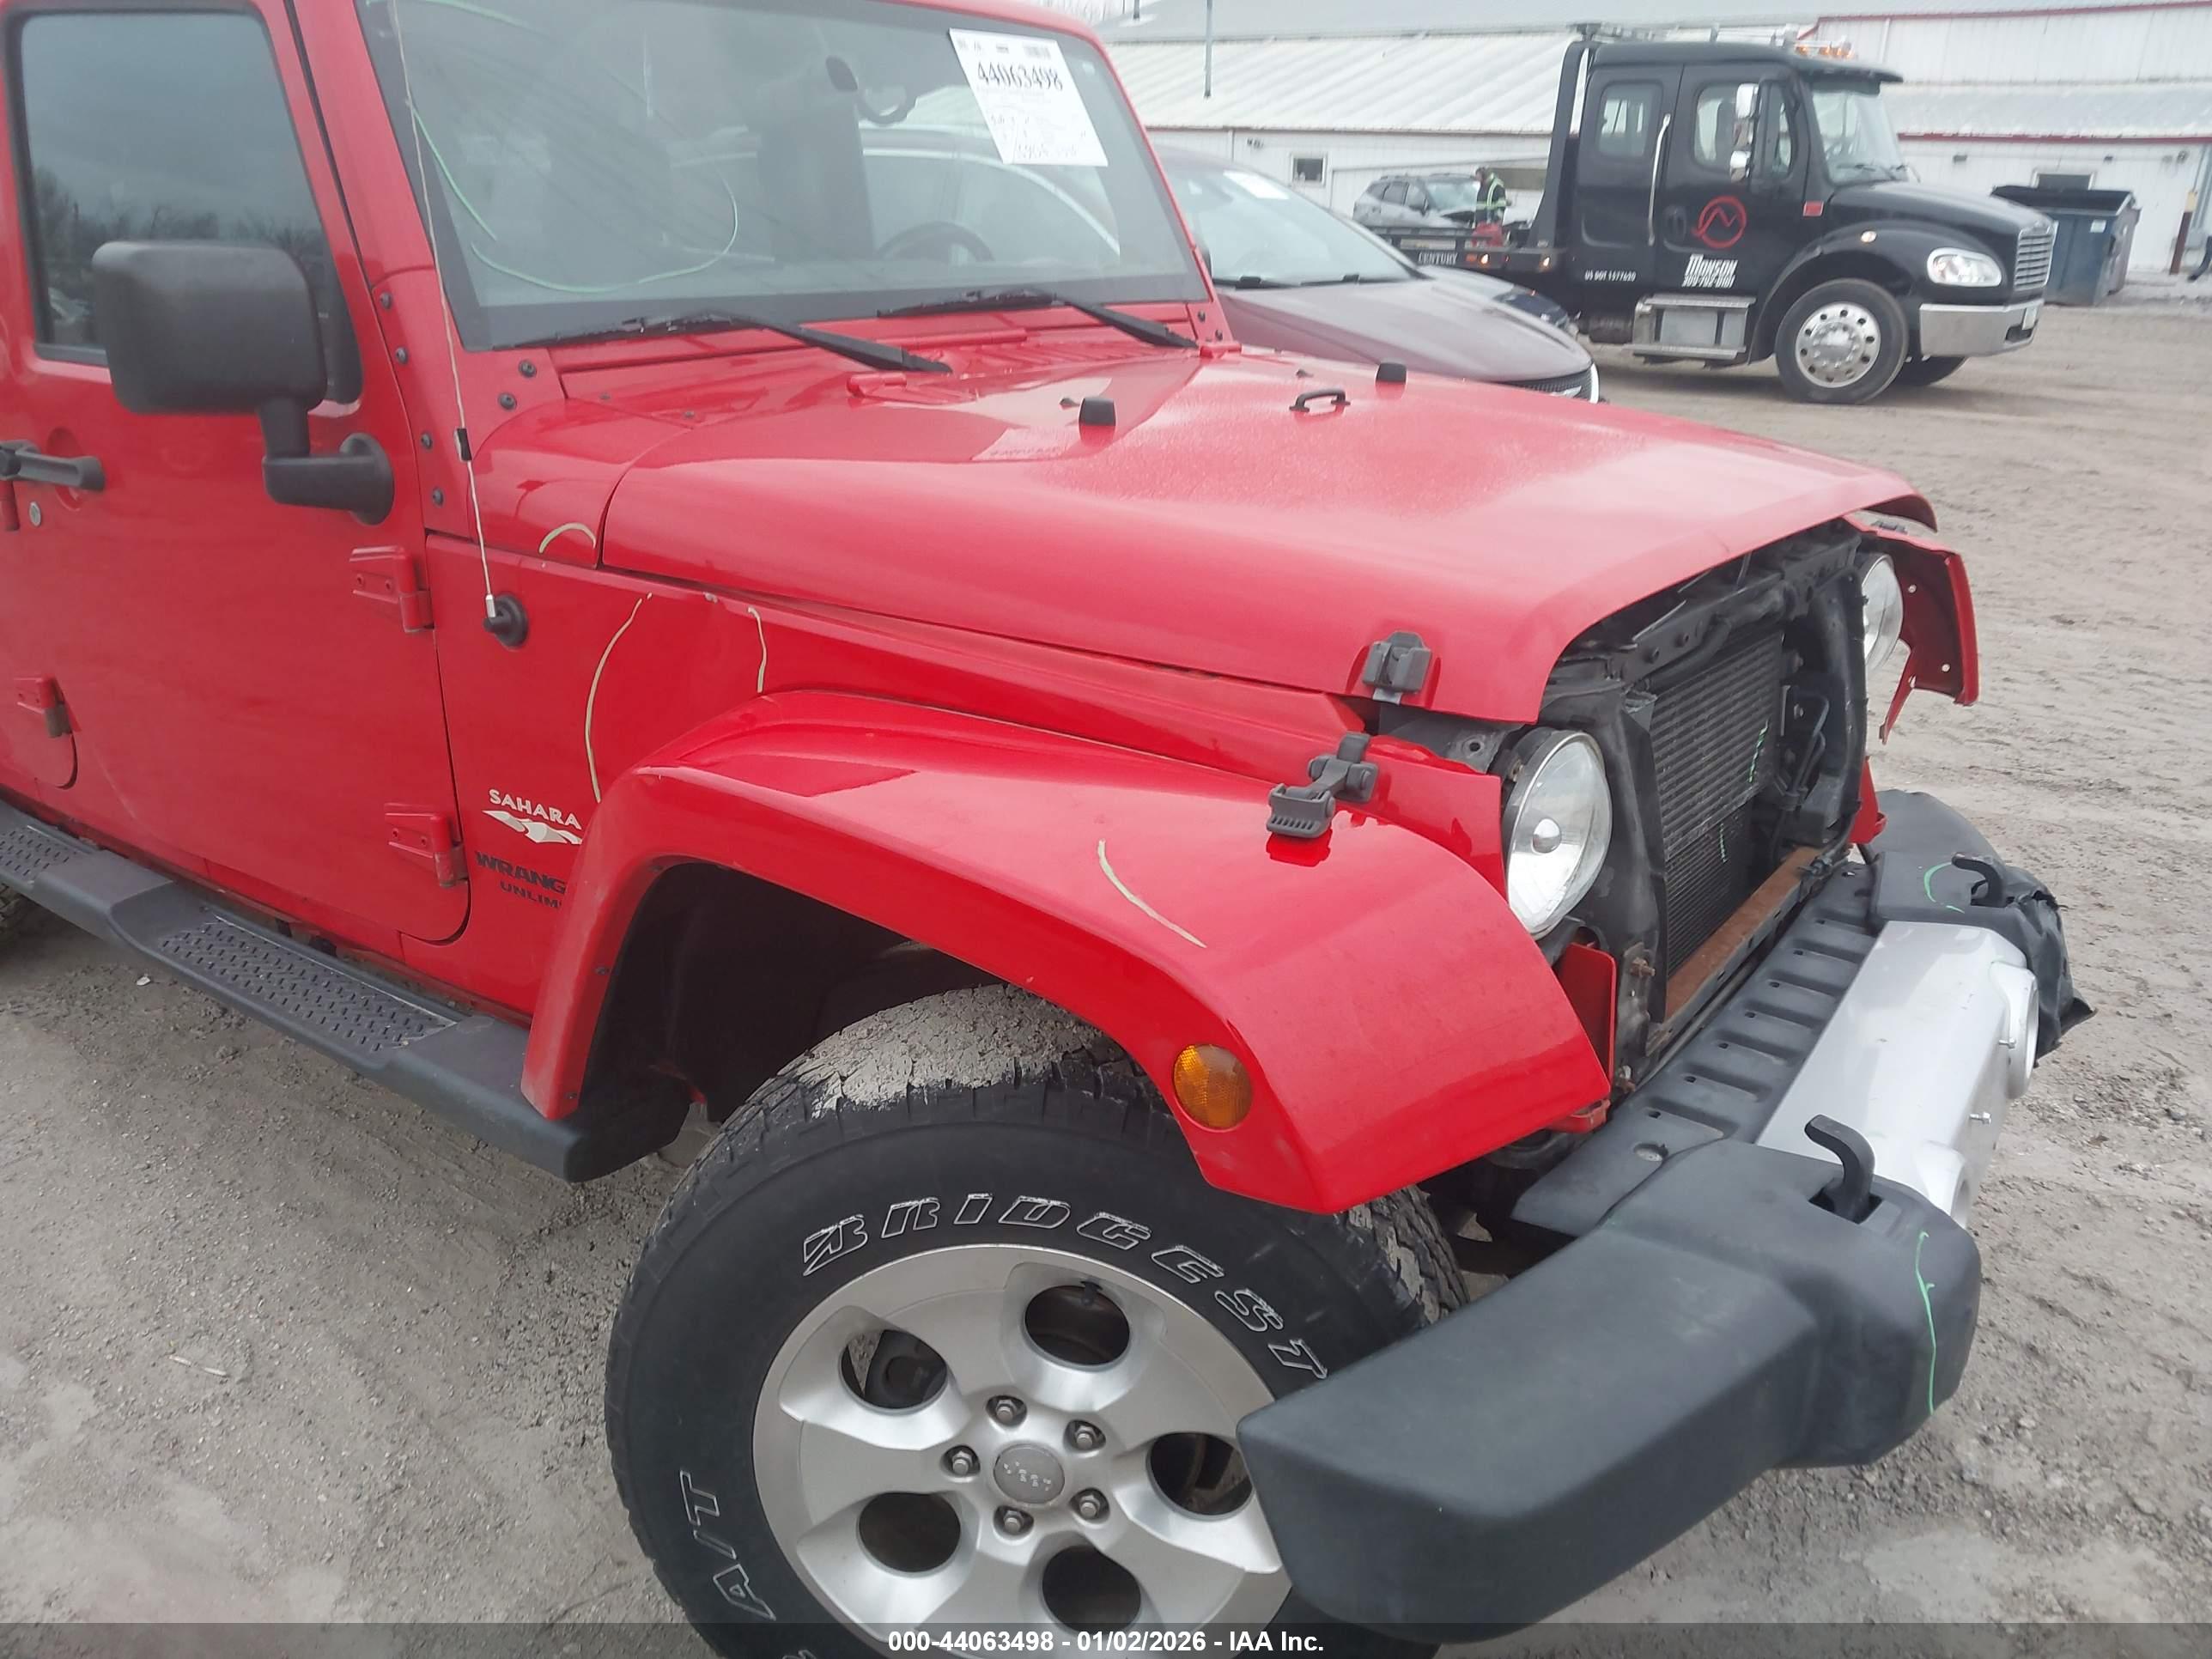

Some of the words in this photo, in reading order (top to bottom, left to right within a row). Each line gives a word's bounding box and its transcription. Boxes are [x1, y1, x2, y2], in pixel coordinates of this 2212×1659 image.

[977, 61, 1063, 91] 44063498
[1418, 252, 1458, 265] CENTURY
[1584, 270, 1594, 281] US
[1594, 270, 1607, 282] DOT
[489, 788, 582, 830] SAHARA
[476, 851, 568, 896] WRANG
[500, 878, 562, 908] UNLIM
[678, 1468, 777, 1622] A/T
